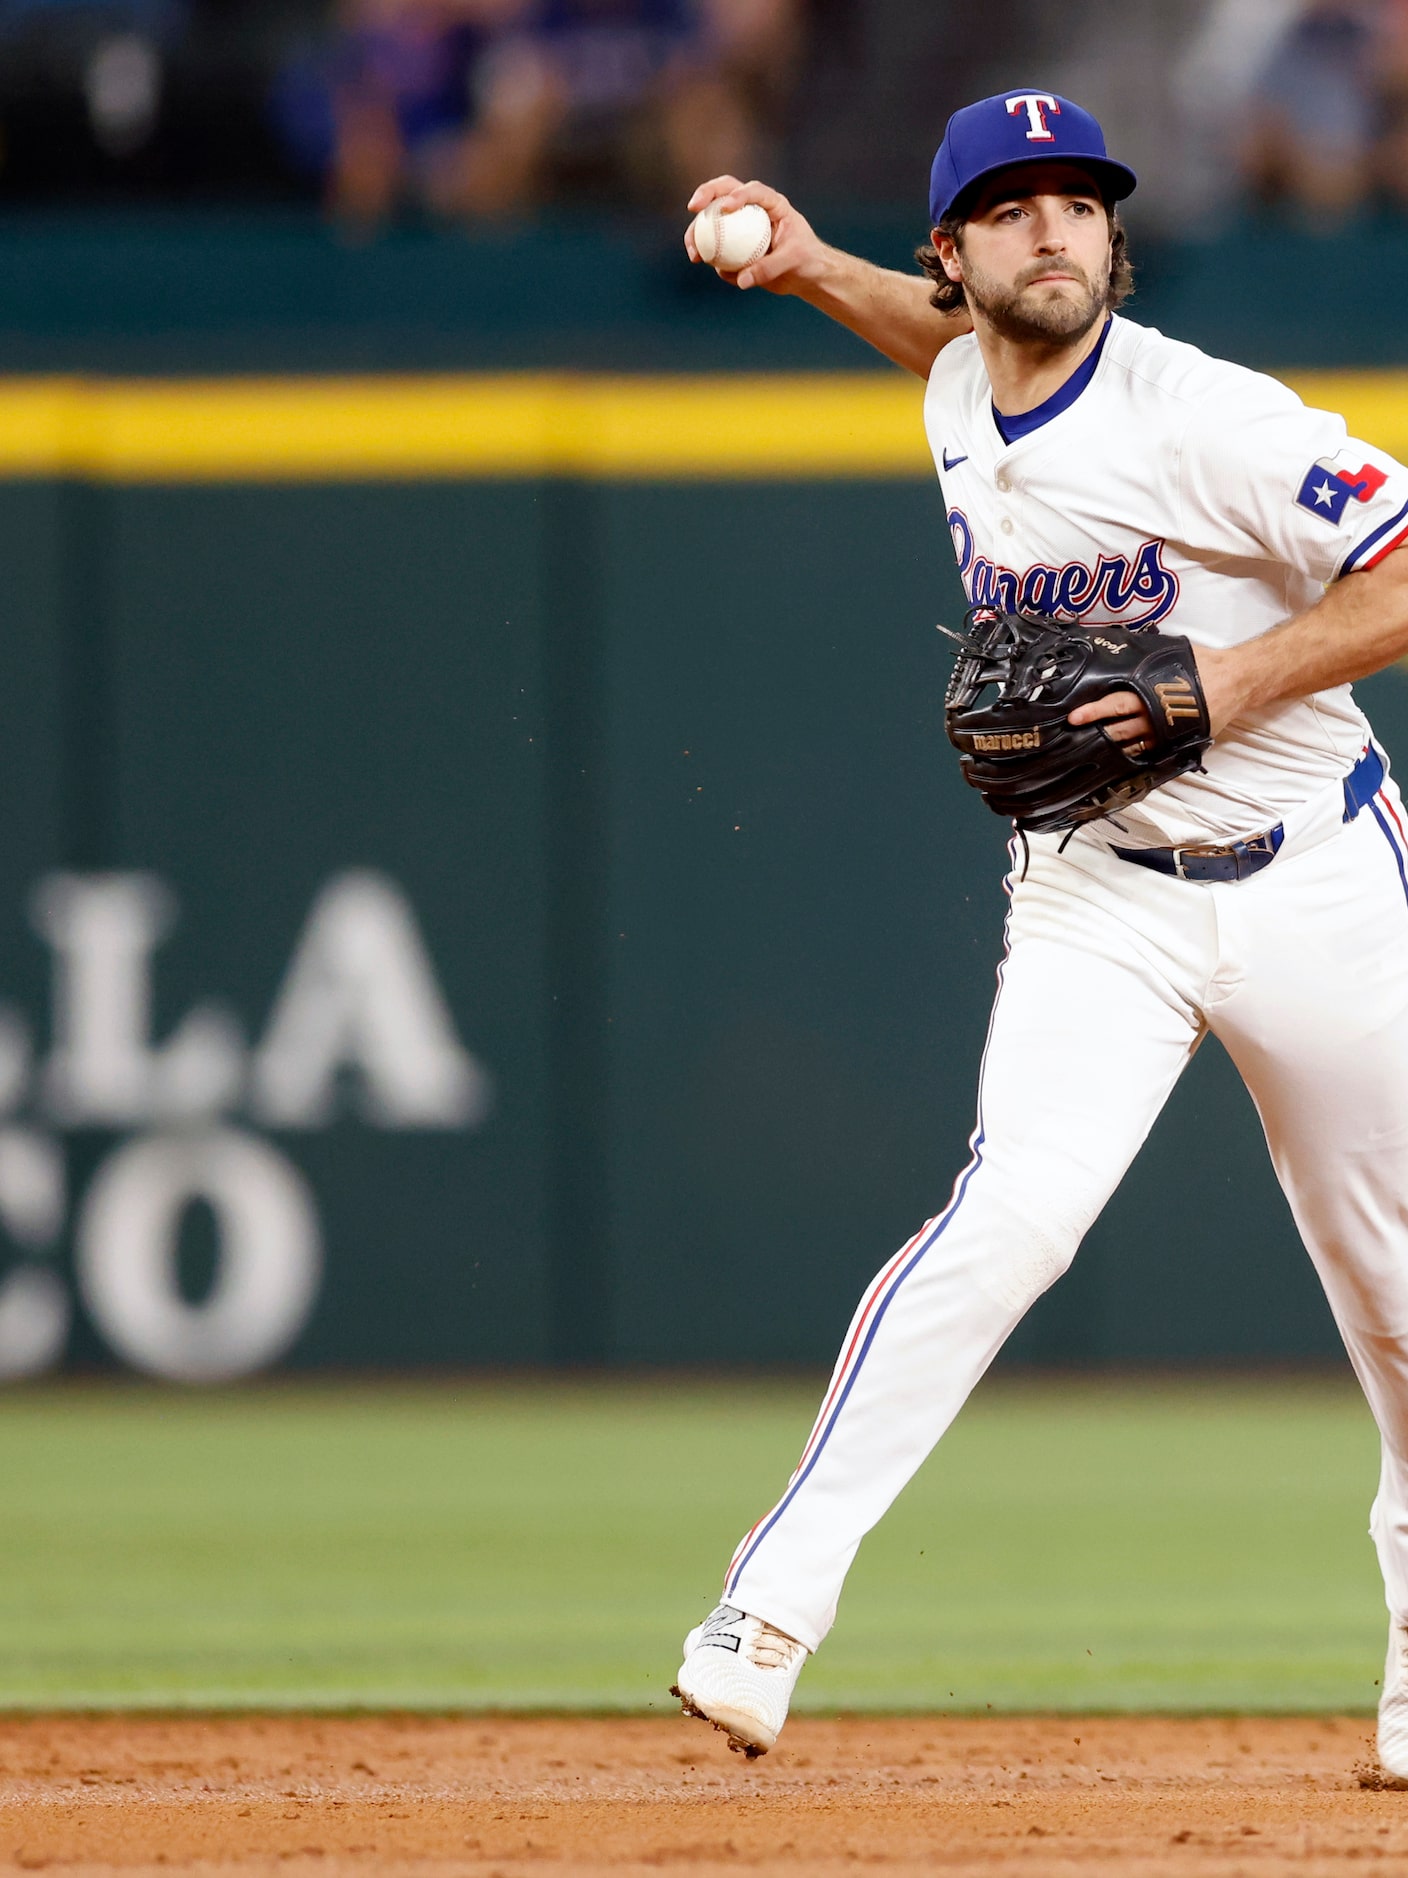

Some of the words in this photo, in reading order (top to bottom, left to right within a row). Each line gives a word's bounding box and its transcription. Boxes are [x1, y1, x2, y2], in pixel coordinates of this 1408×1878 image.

[1005, 94, 1061, 142] T
[972, 725, 1041, 751] marucci
[0, 868, 488, 1130] LA
